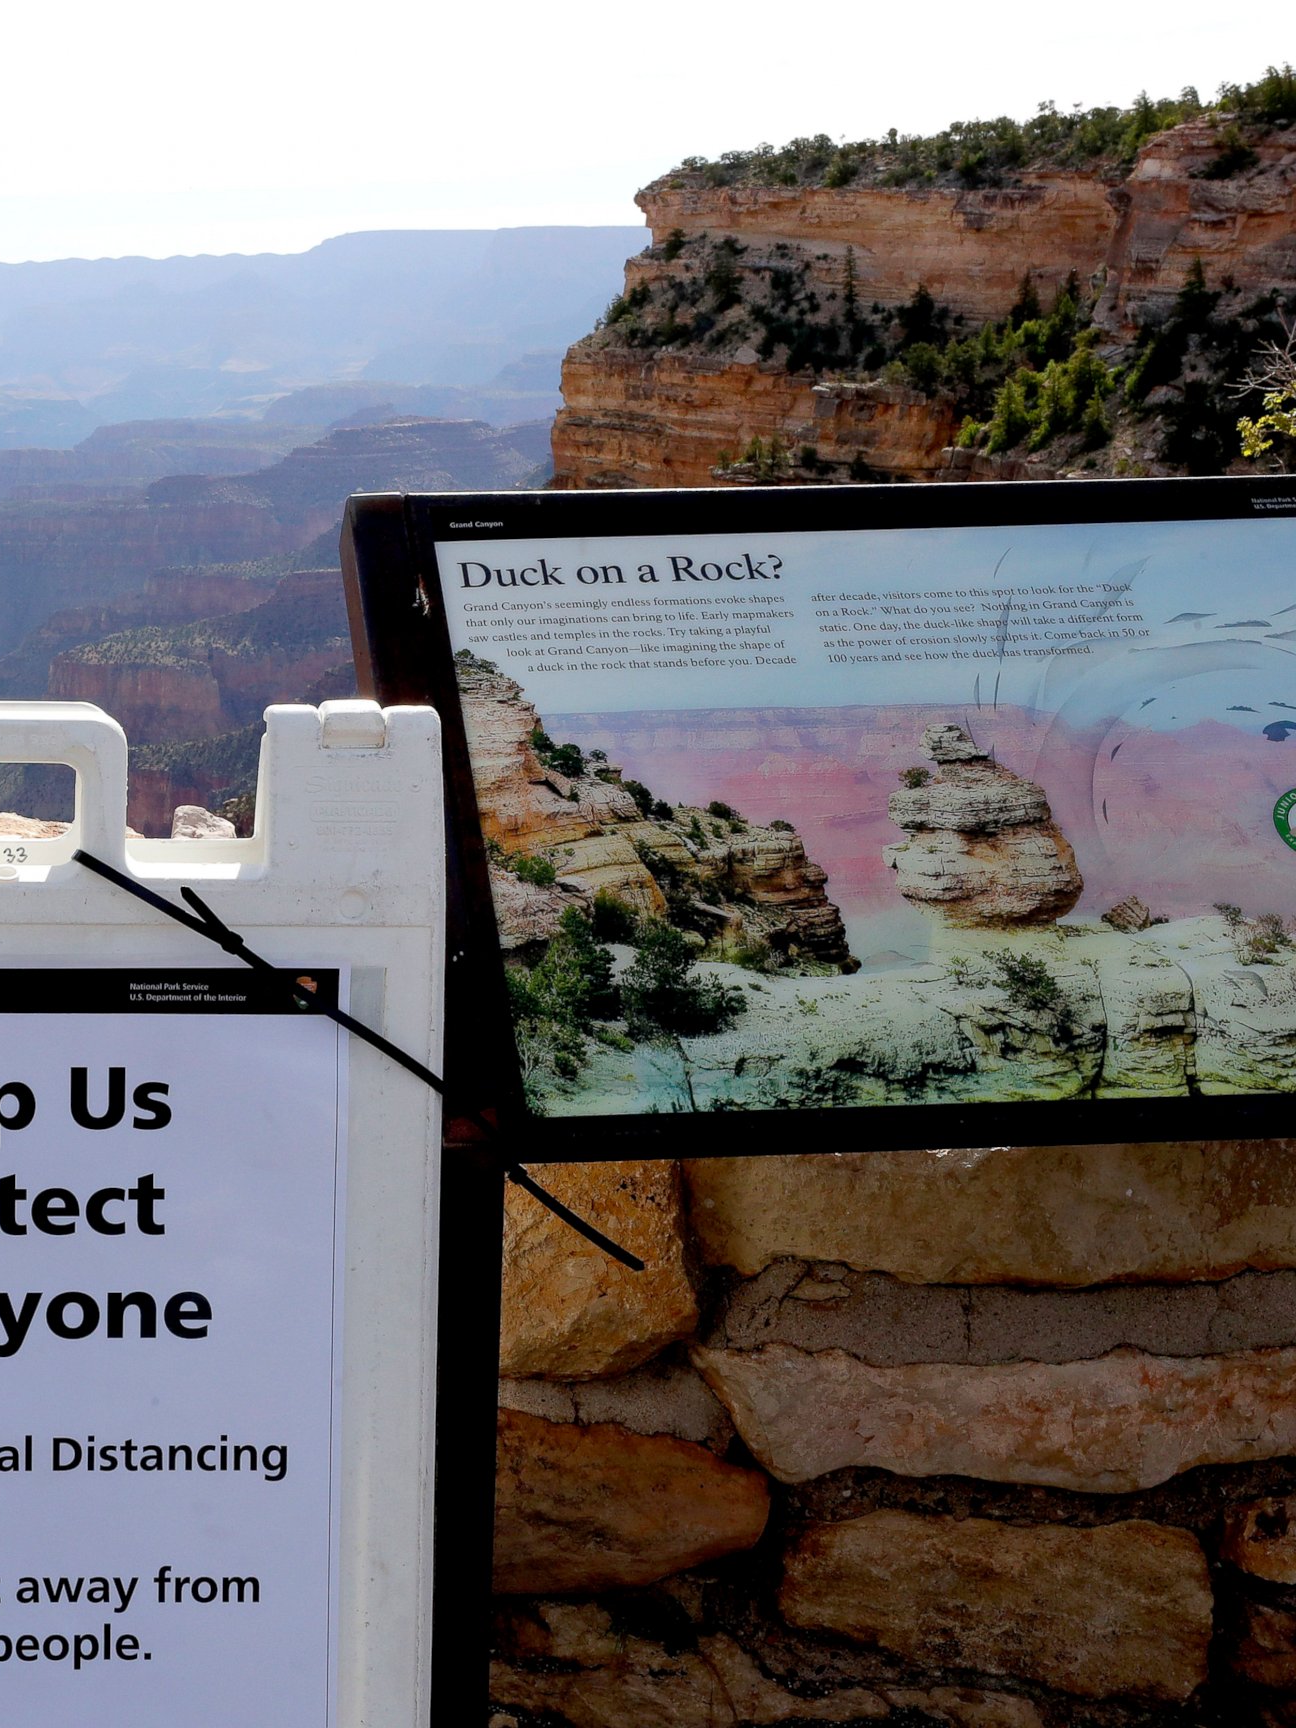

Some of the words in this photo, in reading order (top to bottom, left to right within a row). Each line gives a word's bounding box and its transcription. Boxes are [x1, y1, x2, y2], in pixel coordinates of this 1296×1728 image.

[456, 558, 565, 588] Duck
[576, 565, 626, 584] on
[637, 564, 660, 584] a
[666, 552, 783, 582] Rock?
[463, 601, 498, 611] Grand
[554, 598, 608, 611] seemingly
[611, 598, 651, 608] endless
[653, 597, 712, 606] formations
[715, 595, 746, 605] evoke
[748, 594, 785, 607] shapes
[811, 592, 836, 602] after
[839, 591, 880, 601] decade,
[882, 590, 921, 600] visitors
[955, 589, 967, 597] to
[969, 587, 989, 597] this
[992, 587, 1016, 599] spot
[1017, 587, 1028, 596] to
[1030, 585, 1056, 595] look
[1058, 585, 1074, 594] for
[1077, 584, 1094, 594] the
[880, 605, 910, 615] What
[913, 604, 928, 614] do
[930, 606, 951, 617] you
[954, 603, 975, 613] see?
[981, 602, 1027, 614] Nothing
[1029, 601, 1040, 610] in
[1043, 600, 1078, 610] Grand
[1080, 600, 1122, 611] Canyon
[1125, 598, 1134, 607] is
[466, 617, 487, 627] that
[490, 616, 513, 629] only
[539, 614, 608, 627] imaginations
[632, 613, 662, 625] bring
[665, 613, 675, 621] to
[678, 611, 698, 621] life.
[701, 610, 729, 623] Early
[732, 609, 794, 622] mapmakers
[819, 623, 851, 632] static.
[854, 622, 877, 631] One
[880, 621, 901, 633] day,
[904, 620, 920, 630] the
[923, 618, 974, 629] duck-like
[977, 617, 1008, 629] shape
[1011, 616, 1031, 626] will
[1033, 615, 1056, 625] take
[1068, 614, 1114, 624] different
[1116, 612, 1143, 622] form
[492, 631, 527, 642] castles
[530, 630, 551, 640] and
[554, 630, 596, 642] temples
[599, 630, 609, 639] in
[613, 628, 630, 638] the
[633, 628, 665, 638] rocks.
[668, 628, 685, 640] Try
[689, 626, 723, 638] taking
[734, 625, 771, 638] playful
[837, 638, 855, 648] the
[857, 639, 892, 650] power
[895, 636, 907, 646] of
[910, 635, 950, 645] erosion
[954, 633, 987, 646] slowly
[990, 632, 1028, 645] sculpts
[1031, 632, 1042, 641] it.
[1044, 631, 1077, 640] Come
[1079, 629, 1106, 639] back
[1108, 629, 1119, 638] in
[1122, 628, 1135, 638] 50
[506, 647, 532, 657] look
[535, 648, 544, 656] at
[547, 645, 582, 656] Grand
[663, 642, 717, 655] imagining
[719, 641, 736, 651] the
[739, 640, 771, 652] shape
[774, 639, 785, 649] of
[828, 654, 846, 663] 100
[849, 655, 879, 666] years
[882, 651, 902, 661] and
[925, 650, 949, 660] how
[952, 649, 969, 659] the
[972, 648, 999, 658] duck
[1003, 647, 1021, 657] has
[1023, 644, 1094, 656] transformed.
[537, 662, 564, 672] duck
[566, 662, 578, 671] in
[581, 661, 598, 671] the
[601, 660, 626, 670] rock
[629, 660, 650, 669] that
[653, 658, 688, 668] stands
[691, 658, 726, 667] before
[729, 659, 752, 669] you.
[756, 655, 797, 665] Decade
[130, 993, 144, 1001] U.S.
[146, 994, 192, 1002] Department
[193, 993, 202, 1001] of
[70, 1067, 172, 1130] Us
[52, 1435, 288, 1482] Distancing
[16, 1577, 138, 1613] away
[153, 1566, 260, 1603] from
